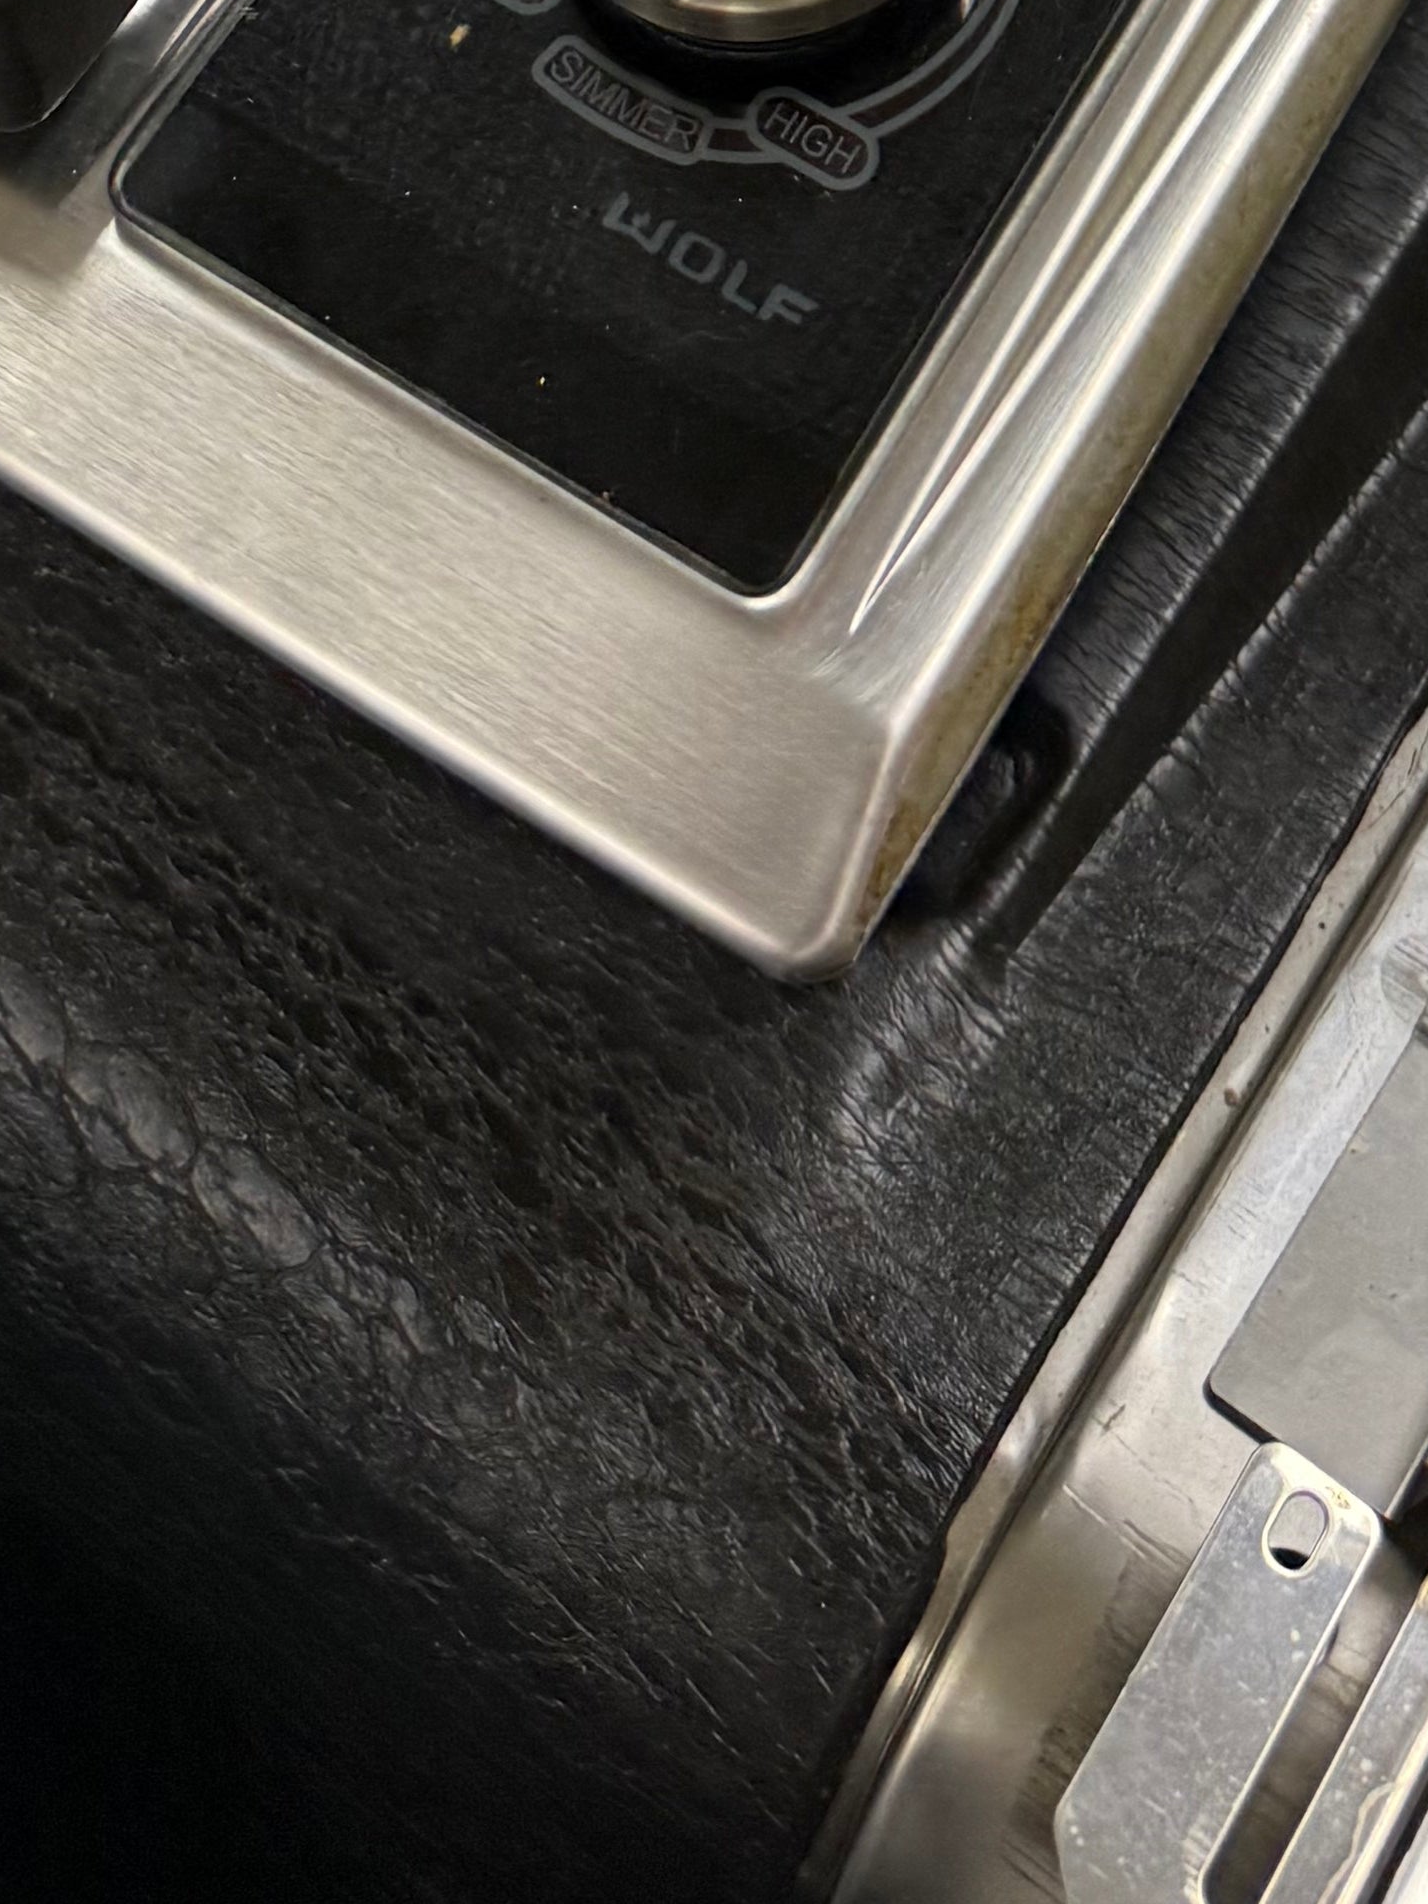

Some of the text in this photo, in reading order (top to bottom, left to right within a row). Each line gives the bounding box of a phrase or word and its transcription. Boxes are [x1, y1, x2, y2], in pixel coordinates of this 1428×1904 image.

[548, 51, 701, 150] SIMMER
[764, 101, 862, 175] HIGH
[600, 192, 821, 325] WOLF
